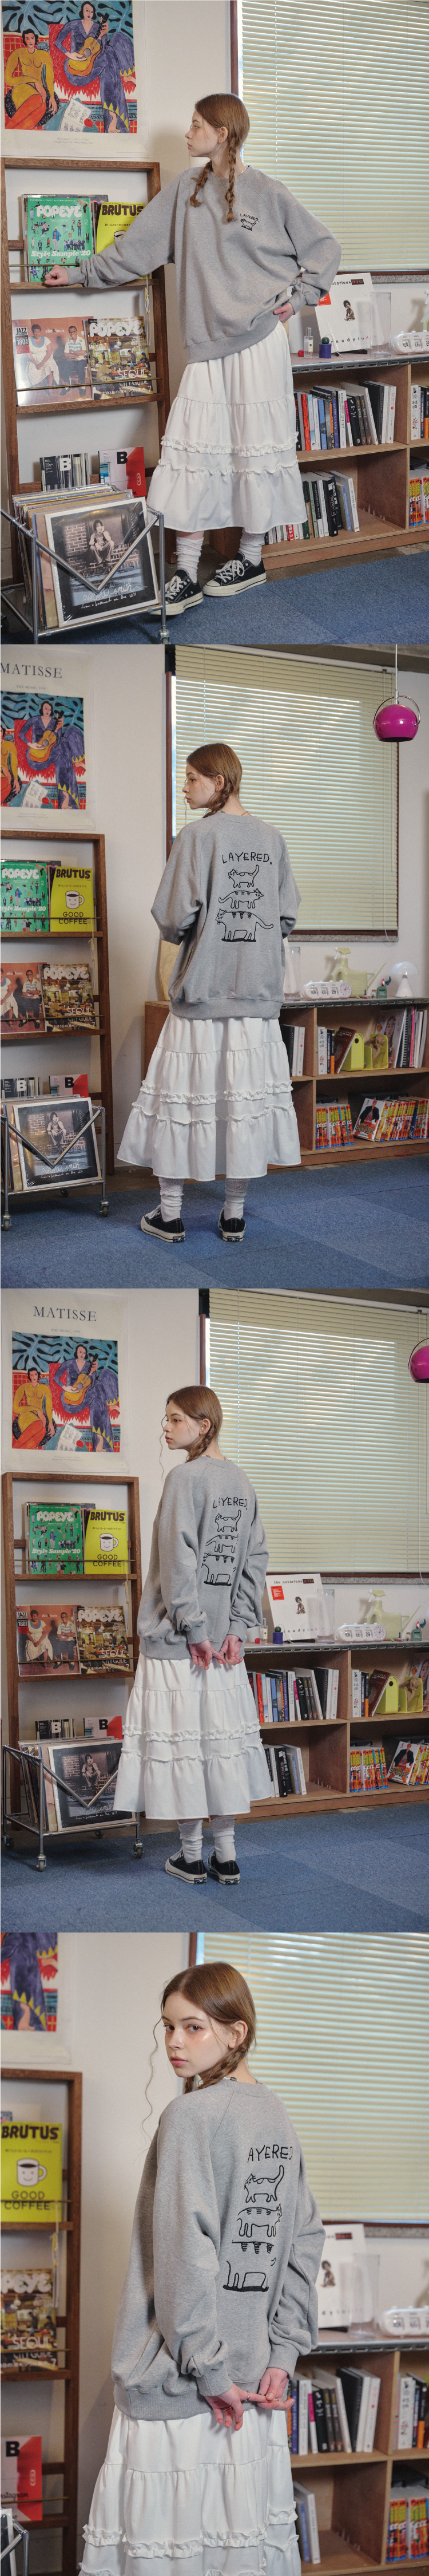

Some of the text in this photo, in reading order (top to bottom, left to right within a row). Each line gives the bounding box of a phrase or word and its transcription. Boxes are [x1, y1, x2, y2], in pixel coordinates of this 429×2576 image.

[36, 205, 82, 218] POPEYE
[102, 204, 144, 216] BRUTUS
[30, 250, 50, 258] Style
[16, 327, 27, 335] JAZZ
[89, 321, 144, 337] POPEYE
[118, 368, 148, 380] SEOUL
[117, 451, 128, 464] B
[59, 457, 71, 472] B
[1, 662, 62, 678] MATISSE
[222, 851, 272, 865] LAYERED.
[2, 868, 39, 879] POPEYE
[55, 868, 91, 879] BRUTUS
[43, 967, 89, 979] POPEYE
[67, 1008, 92, 1016] SEOUL
[16, 1080, 27, 1092] B
[65, 1077, 74, 1088] B
[33, 1306, 97, 1322] MATISSE
[37, 1511, 74, 1522] POPEYE
[90, 1511, 125, 1522] BRUTUS
[78, 1609, 124, 1622] POPEYE
[101, 1649, 126, 1658] SEOUL
[51, 1721, 62, 1733] B
[99, 1719, 109, 1730] B
[1, 2124, 59, 2140] BRUTUS
[247, 2144, 293, 2163] AYERED
[11, 2190, 45, 2200] GOOD
[4, 2201, 50, 2210] COFFEE
[13, 2336, 50, 2350] SEOUL
[50, 2358, 57, 2367] 7
[6, 2441, 20, 2457] B
